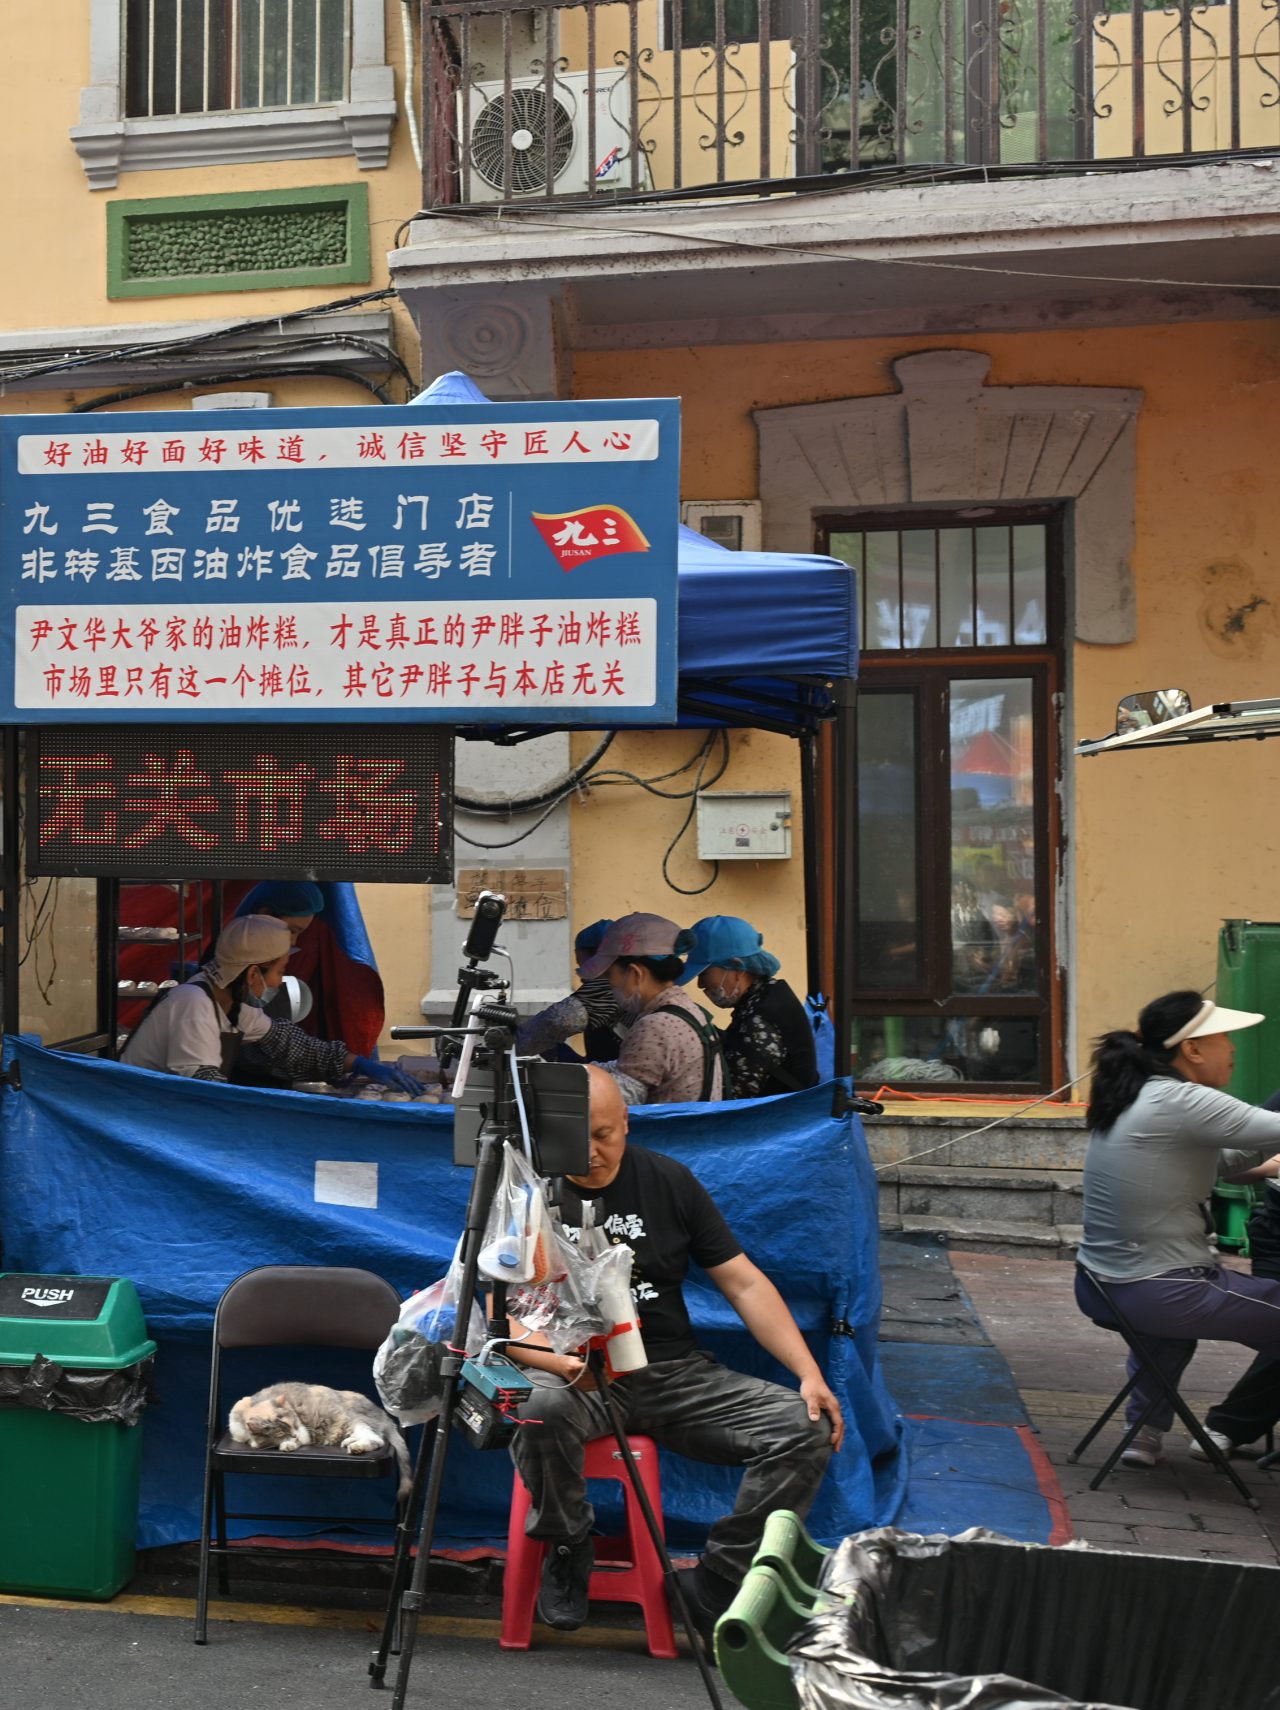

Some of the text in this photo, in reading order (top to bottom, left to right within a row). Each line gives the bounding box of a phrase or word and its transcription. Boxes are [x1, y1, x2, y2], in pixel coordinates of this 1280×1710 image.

[22, 492, 495, 536] 九三食品优选门店
[552, 517, 621, 547] 九三
[21, 541, 498, 584] 非转基因油炸食品倡导者
[561, 549, 592, 558] JIUSAN
[39, 749, 420, 853] 无关市场
[21, 1287, 75, 1301] PUSH
